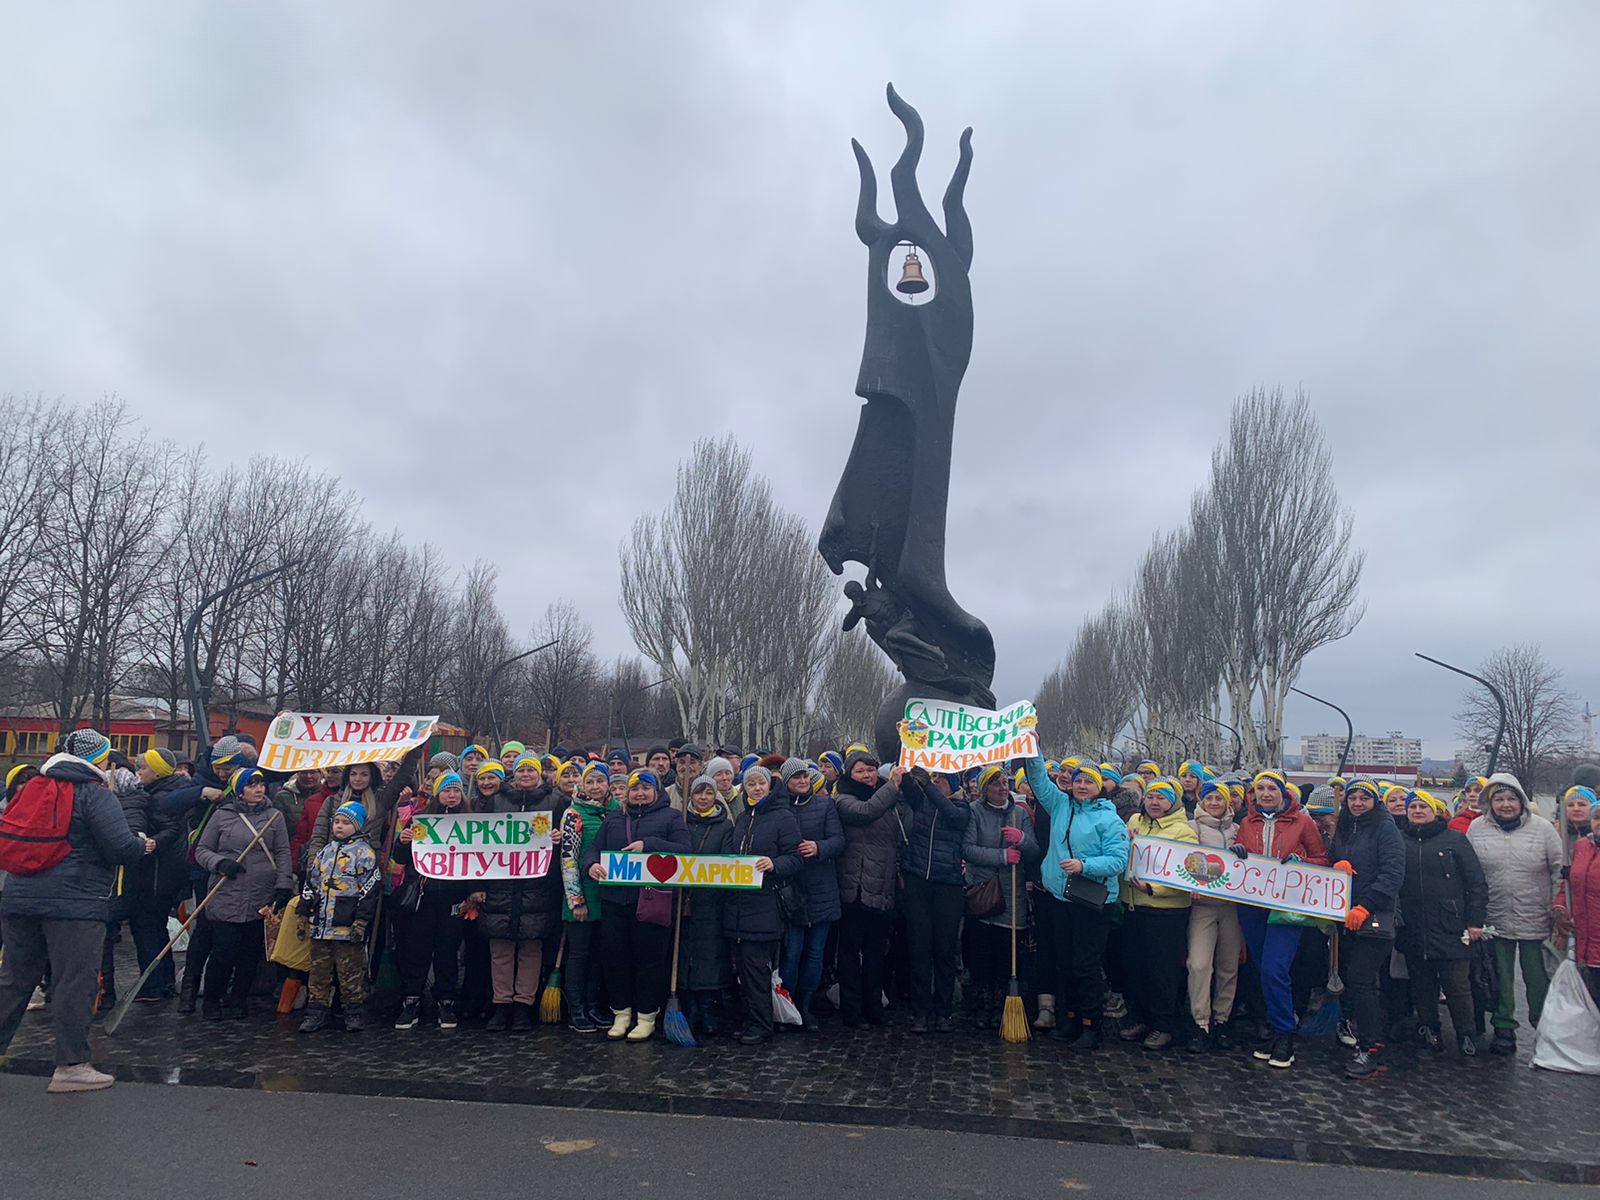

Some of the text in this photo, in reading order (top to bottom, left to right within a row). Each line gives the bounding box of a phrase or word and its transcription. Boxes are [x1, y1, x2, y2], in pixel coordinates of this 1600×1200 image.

[296, 715, 411, 743] ХАРКІВ
[927, 724, 1019, 750] РАЙОН
[416, 814, 531, 845] ХАРКІВ
[414, 845, 553, 877] КВІТУЧИЙ
[1129, 843, 1346, 910] МИ ХАРКІВ
